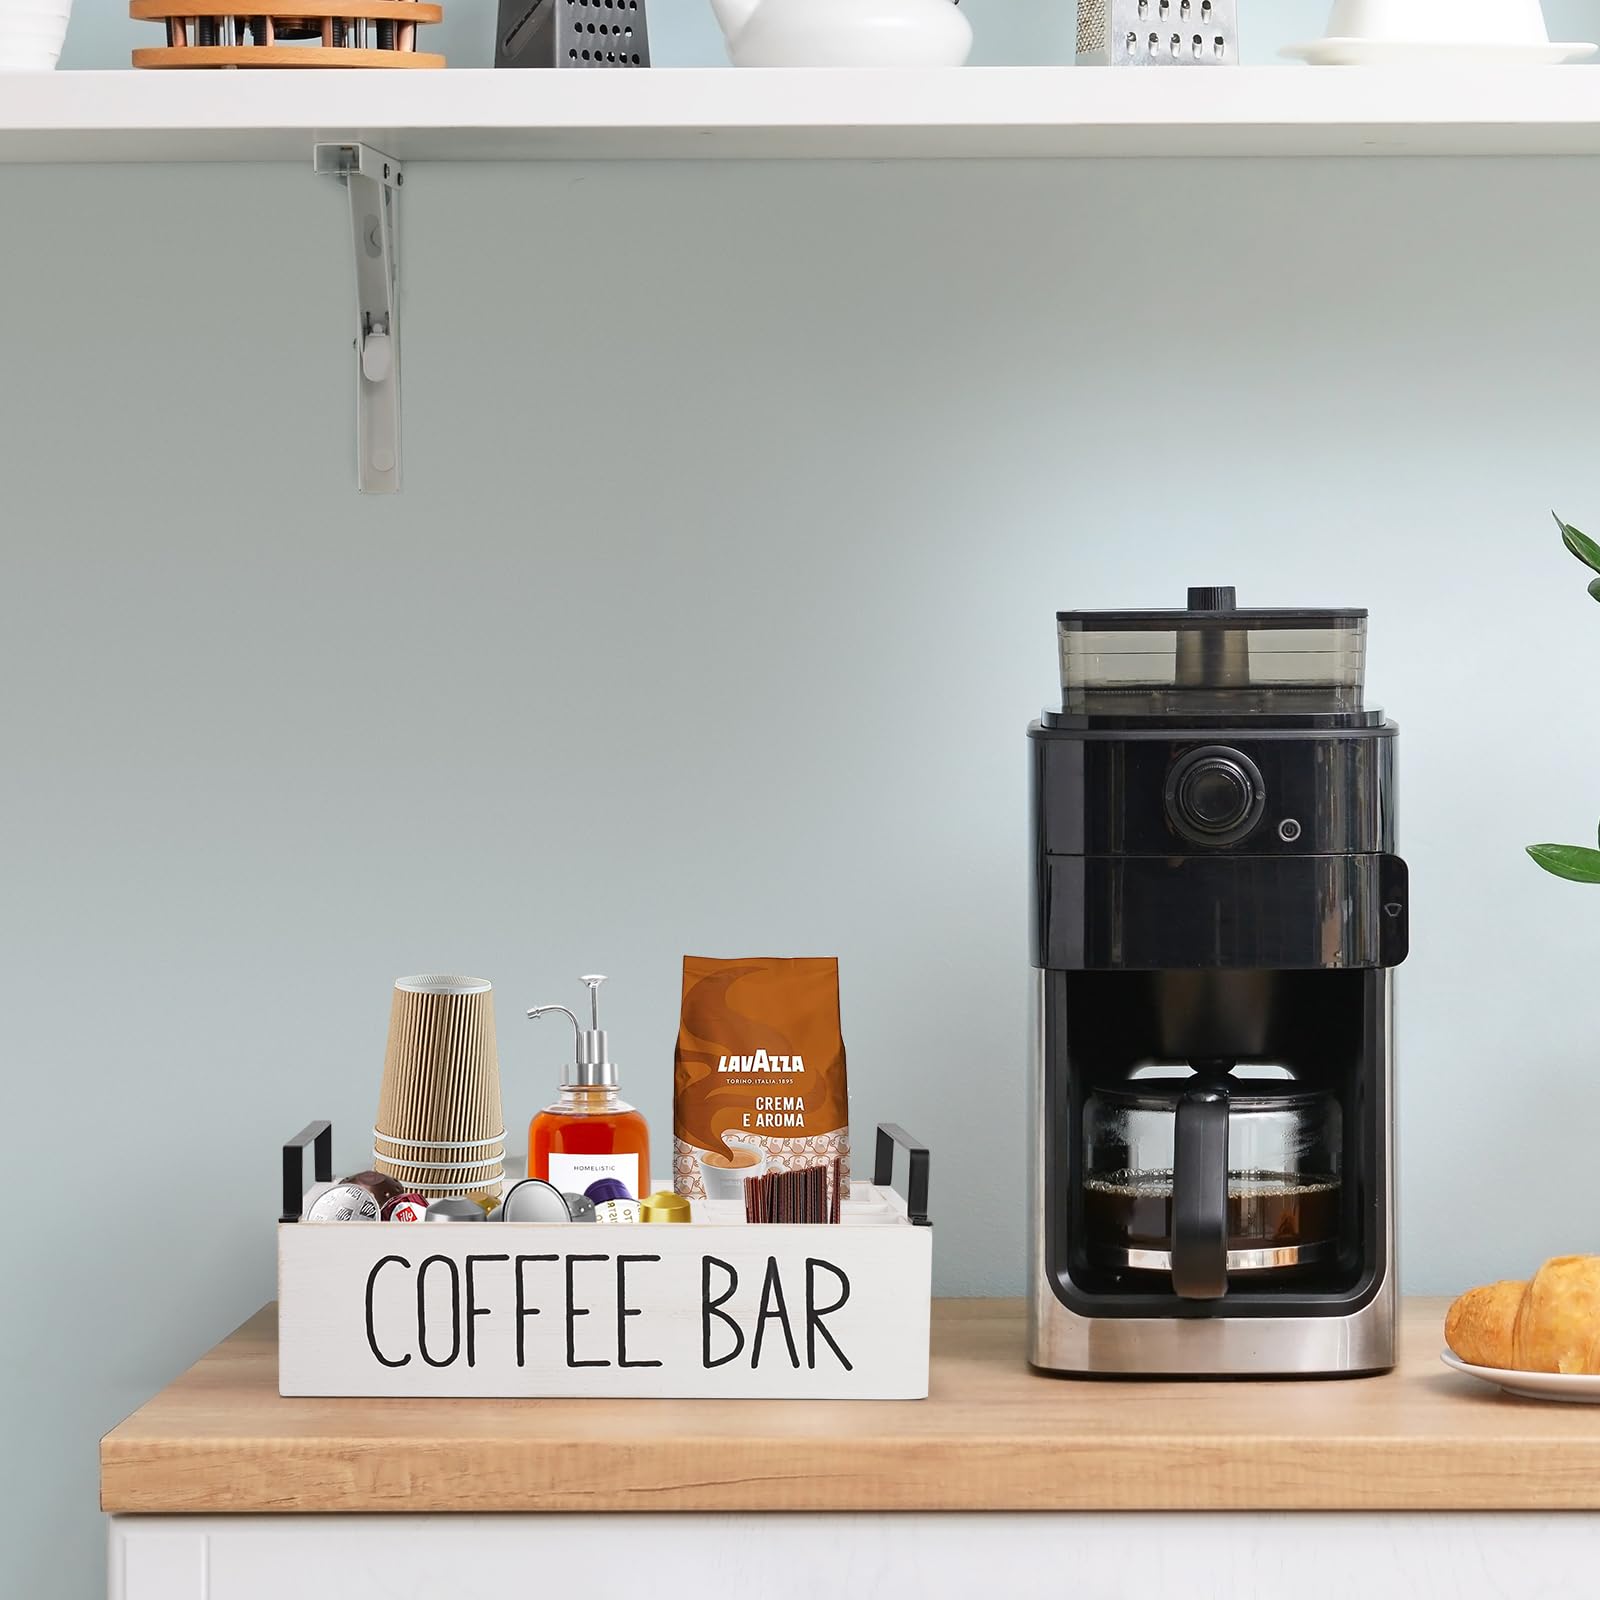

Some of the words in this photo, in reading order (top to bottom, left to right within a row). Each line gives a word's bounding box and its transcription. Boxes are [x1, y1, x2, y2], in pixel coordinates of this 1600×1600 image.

[718, 1049, 805, 1072] LAVAZZA
[756, 1096, 805, 1111] CREMA
[743, 1113, 751, 1127] E
[756, 1113, 805, 1128] AROMA
[366, 1254, 663, 1368] COFFEE
[702, 1255, 853, 1370] BAR
